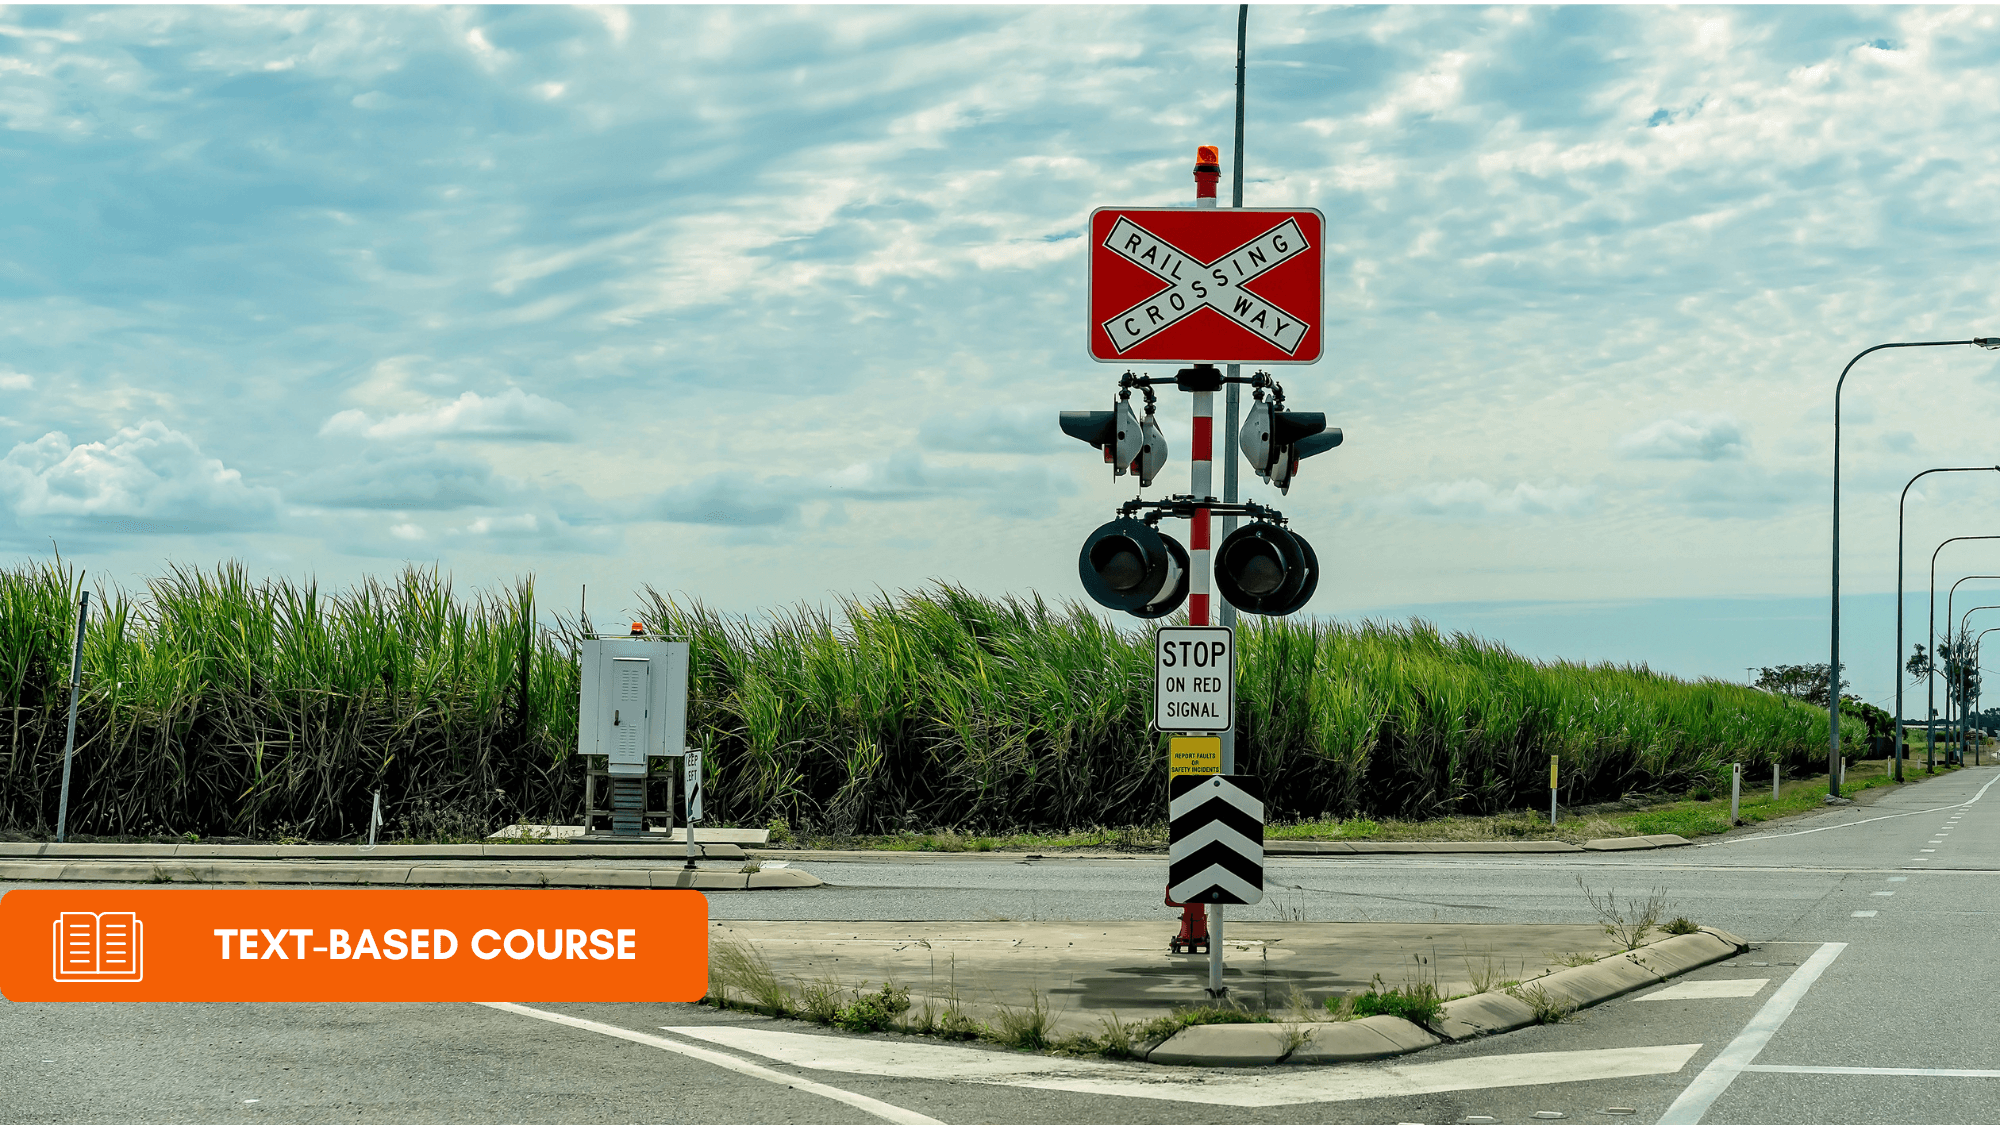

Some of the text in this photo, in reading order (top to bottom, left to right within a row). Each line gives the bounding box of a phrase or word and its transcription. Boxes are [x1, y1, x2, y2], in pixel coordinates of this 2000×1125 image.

[1124, 233, 1290, 337] RAIL WAY
[1124, 234, 1288, 336] CROSSING
[1162, 641, 1226, 667] STOP
[1166, 677, 1222, 692] ON RED
[1167, 702, 1219, 717] SIGNAL
